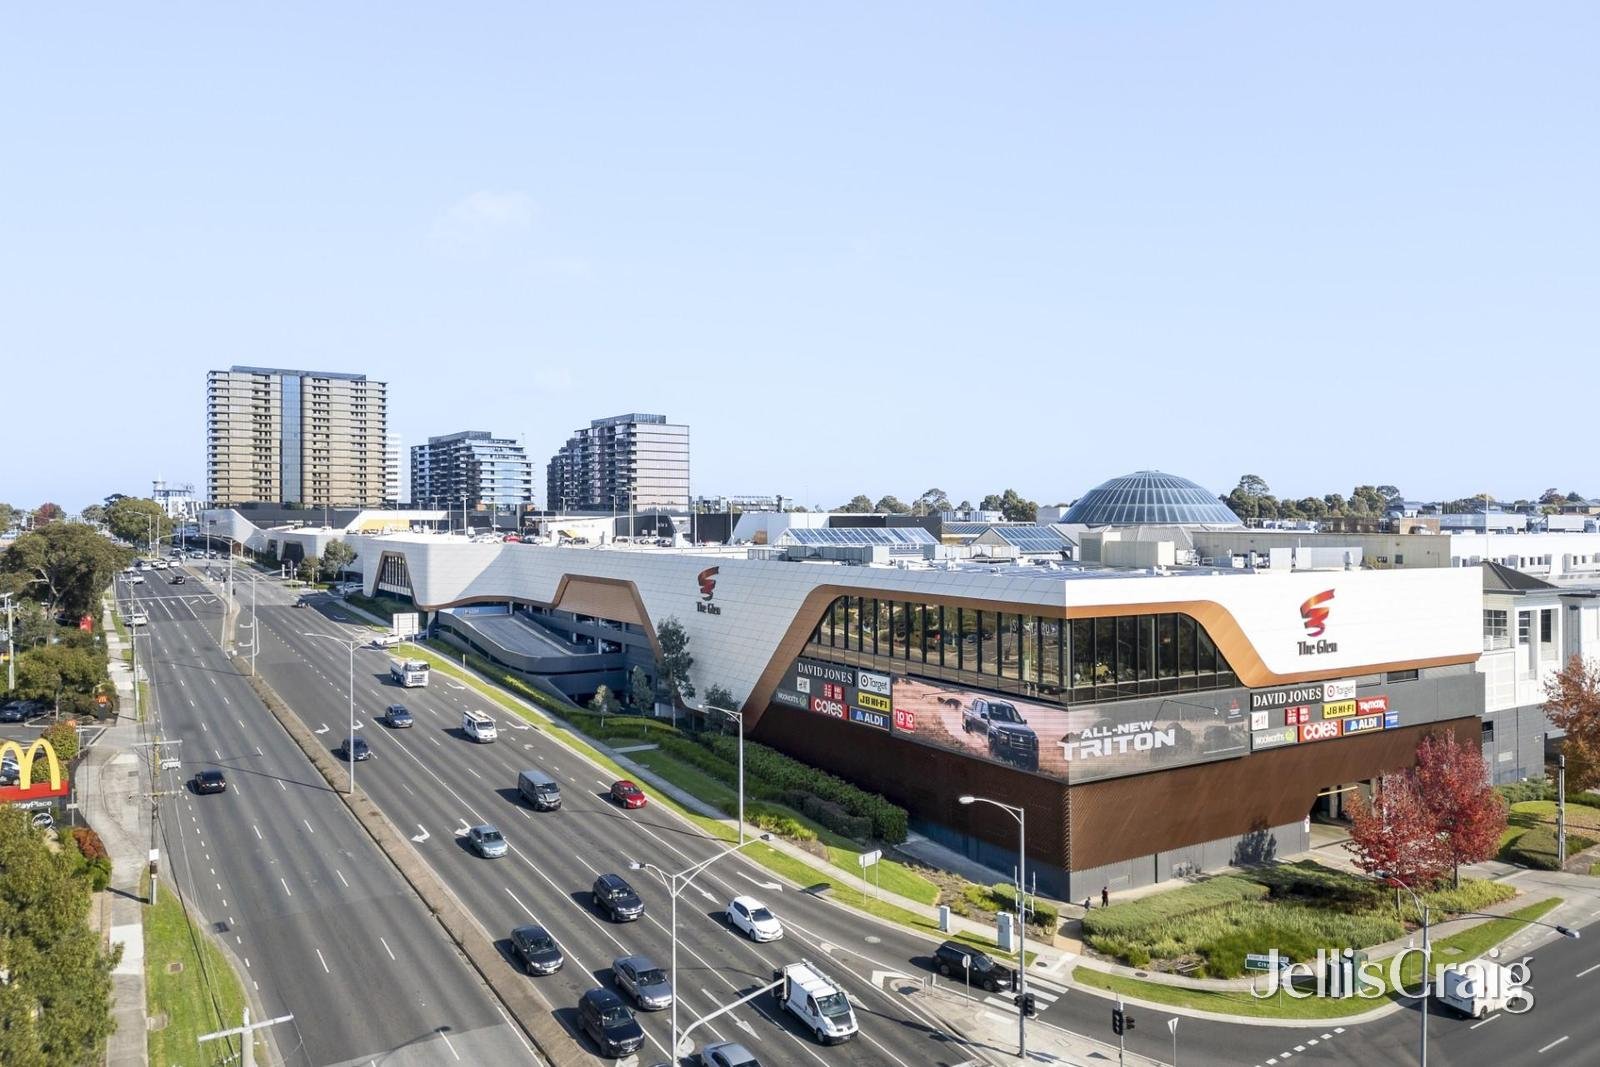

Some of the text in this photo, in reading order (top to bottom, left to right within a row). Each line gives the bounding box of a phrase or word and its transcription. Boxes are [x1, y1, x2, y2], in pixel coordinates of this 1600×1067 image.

[1297, 639, 1338, 656] The Glen
[798, 662, 853, 684] DAVID JONES
[869, 677, 888, 691] Target
[859, 695, 870, 705] JB
[1253, 688, 1322, 707] DAVID JONES
[814, 698, 843, 718] coles
[1326, 704, 1354, 716] JB HI-FI
[864, 713, 883, 727] ALDI
[1358, 717, 1377, 730] ALDI
[1081, 721, 1153, 740] ALL-NEW
[1303, 721, 1338, 740] coles
[1057, 729, 1175, 761] TRITON
